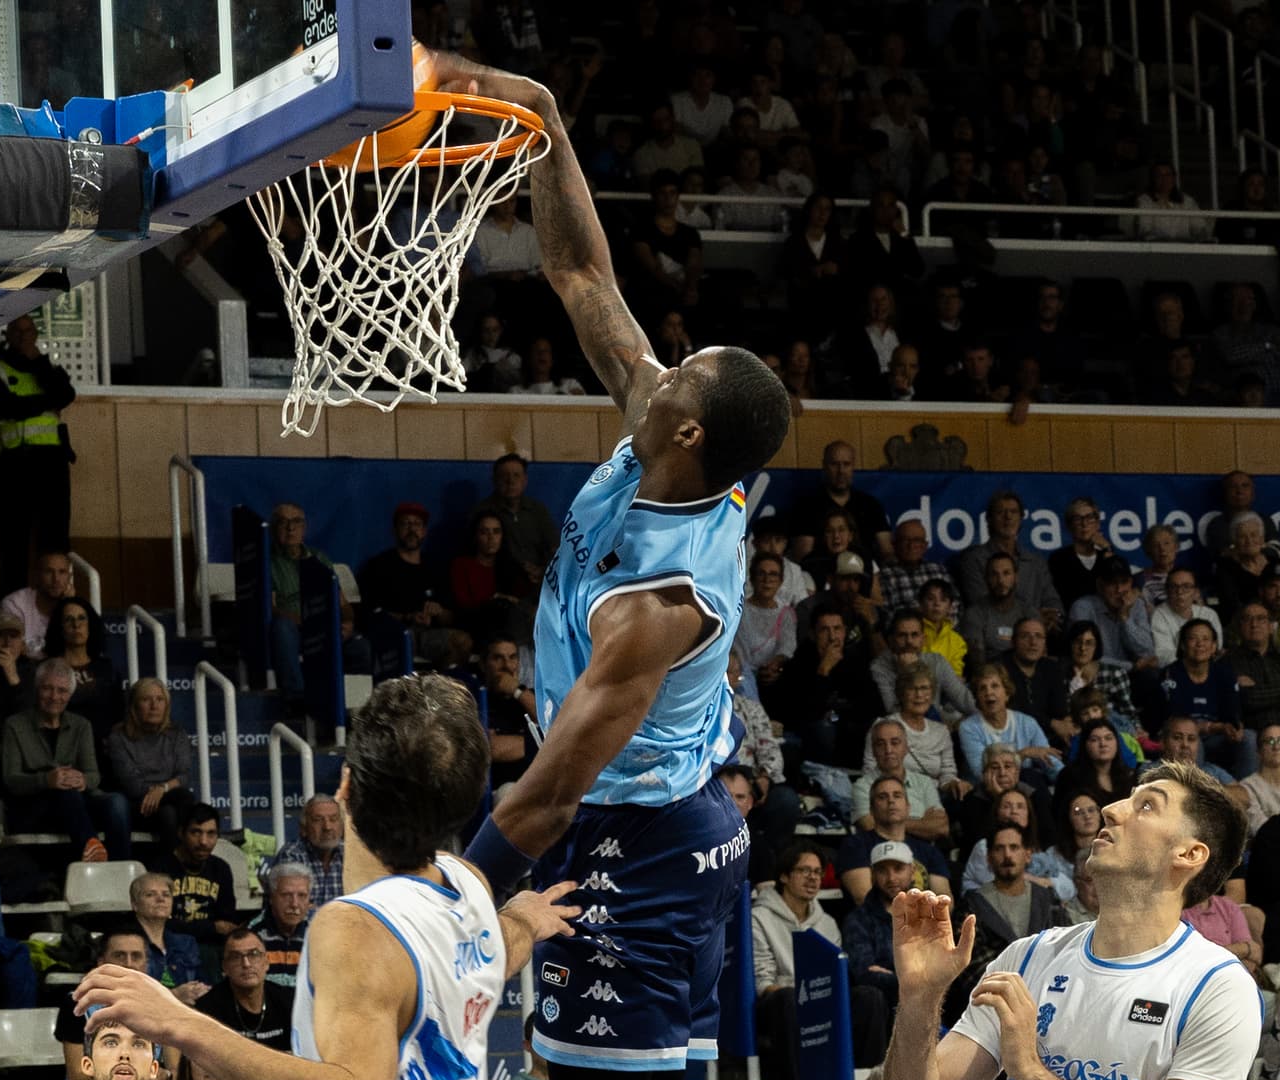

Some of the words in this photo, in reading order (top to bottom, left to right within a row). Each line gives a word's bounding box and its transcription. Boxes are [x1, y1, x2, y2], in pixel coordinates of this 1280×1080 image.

[205, 732, 269, 747] telcom
[544, 970, 562, 983] acb
[1133, 1003, 1149, 1016] liga
[1131, 1013, 1163, 1024] endesa
